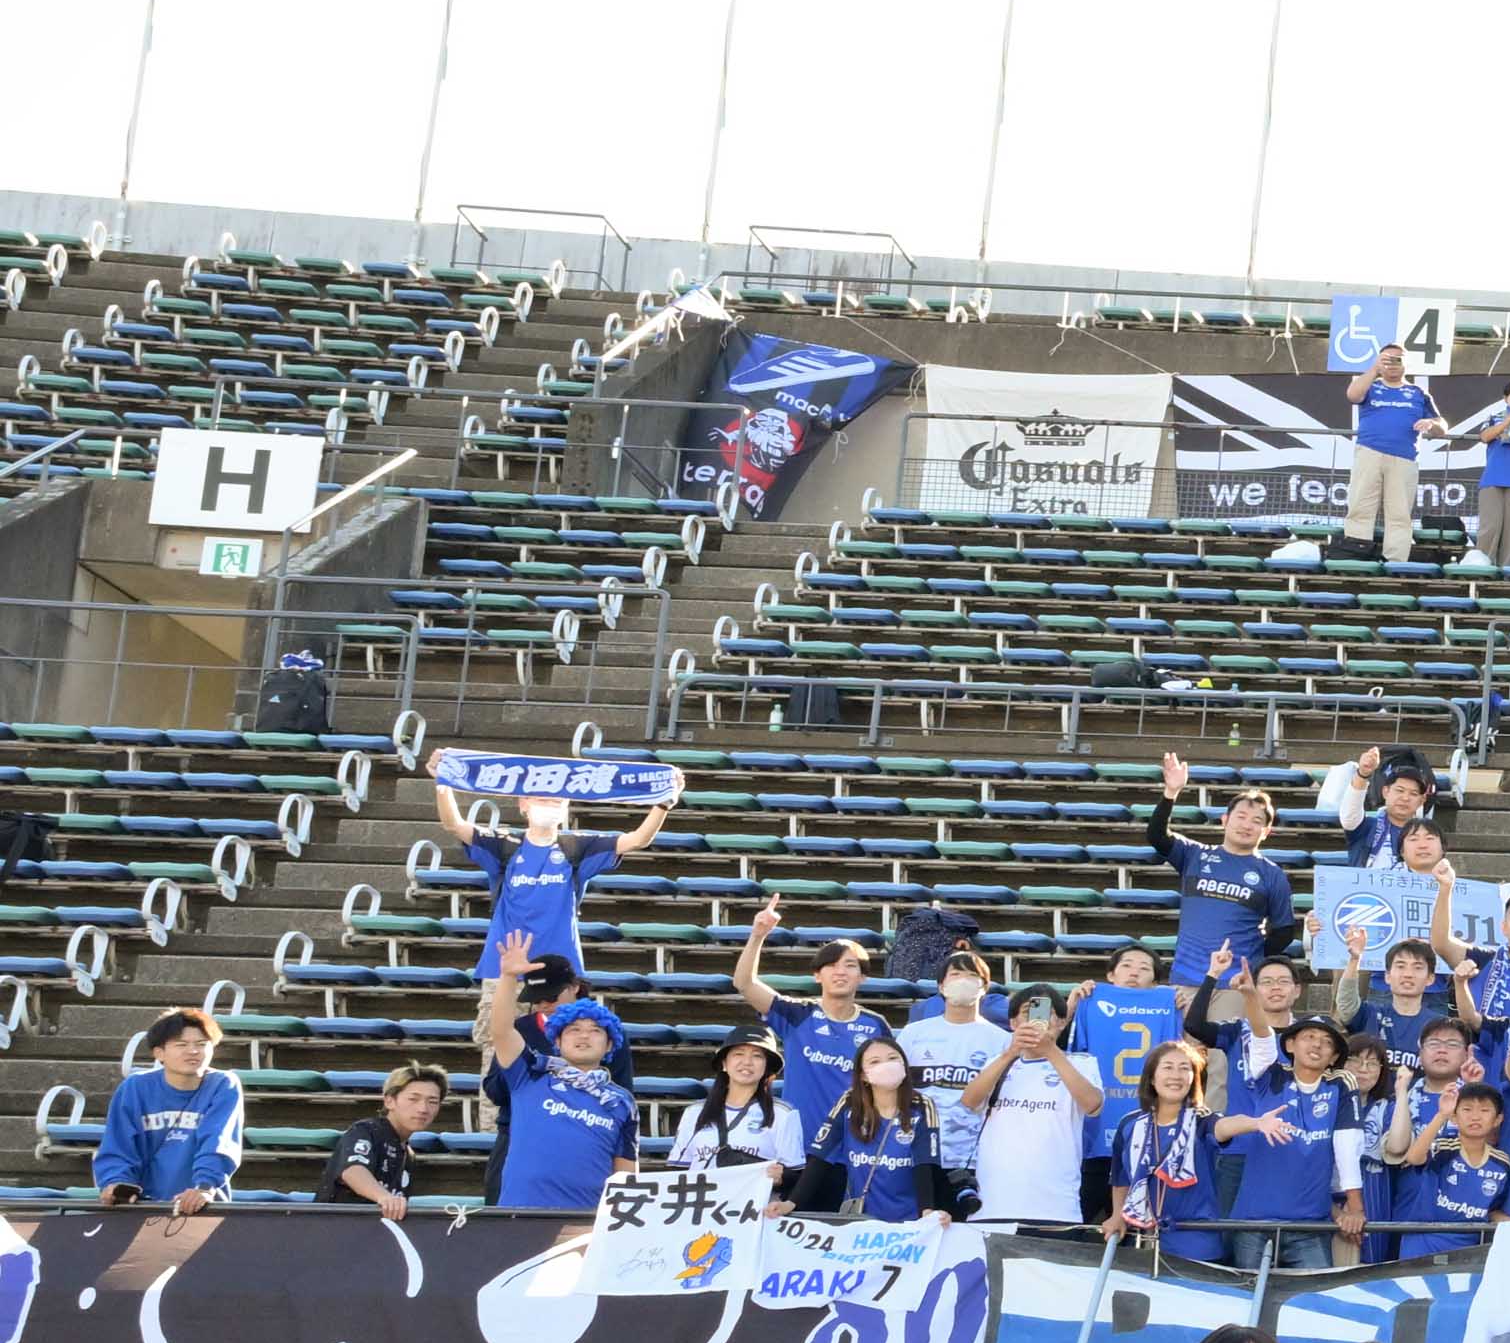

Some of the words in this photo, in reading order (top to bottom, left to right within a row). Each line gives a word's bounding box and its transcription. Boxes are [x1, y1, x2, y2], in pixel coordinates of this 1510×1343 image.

[1404, 308, 1440, 364] 4
[200, 446, 271, 515] H
[959, 438, 1143, 493] Casuals
[474, 763, 620, 795] 町田魂
[1196, 877, 1253, 901] ABEMA
[1454, 913, 1502, 947] J1
[1117, 1004, 1172, 1019] odakyu
[1113, 1022, 1151, 1086] 2
[543, 1095, 615, 1130] CyberAgent
[760, 1268, 866, 1299] ARAKI
[871, 1264, 903, 1302] 7
